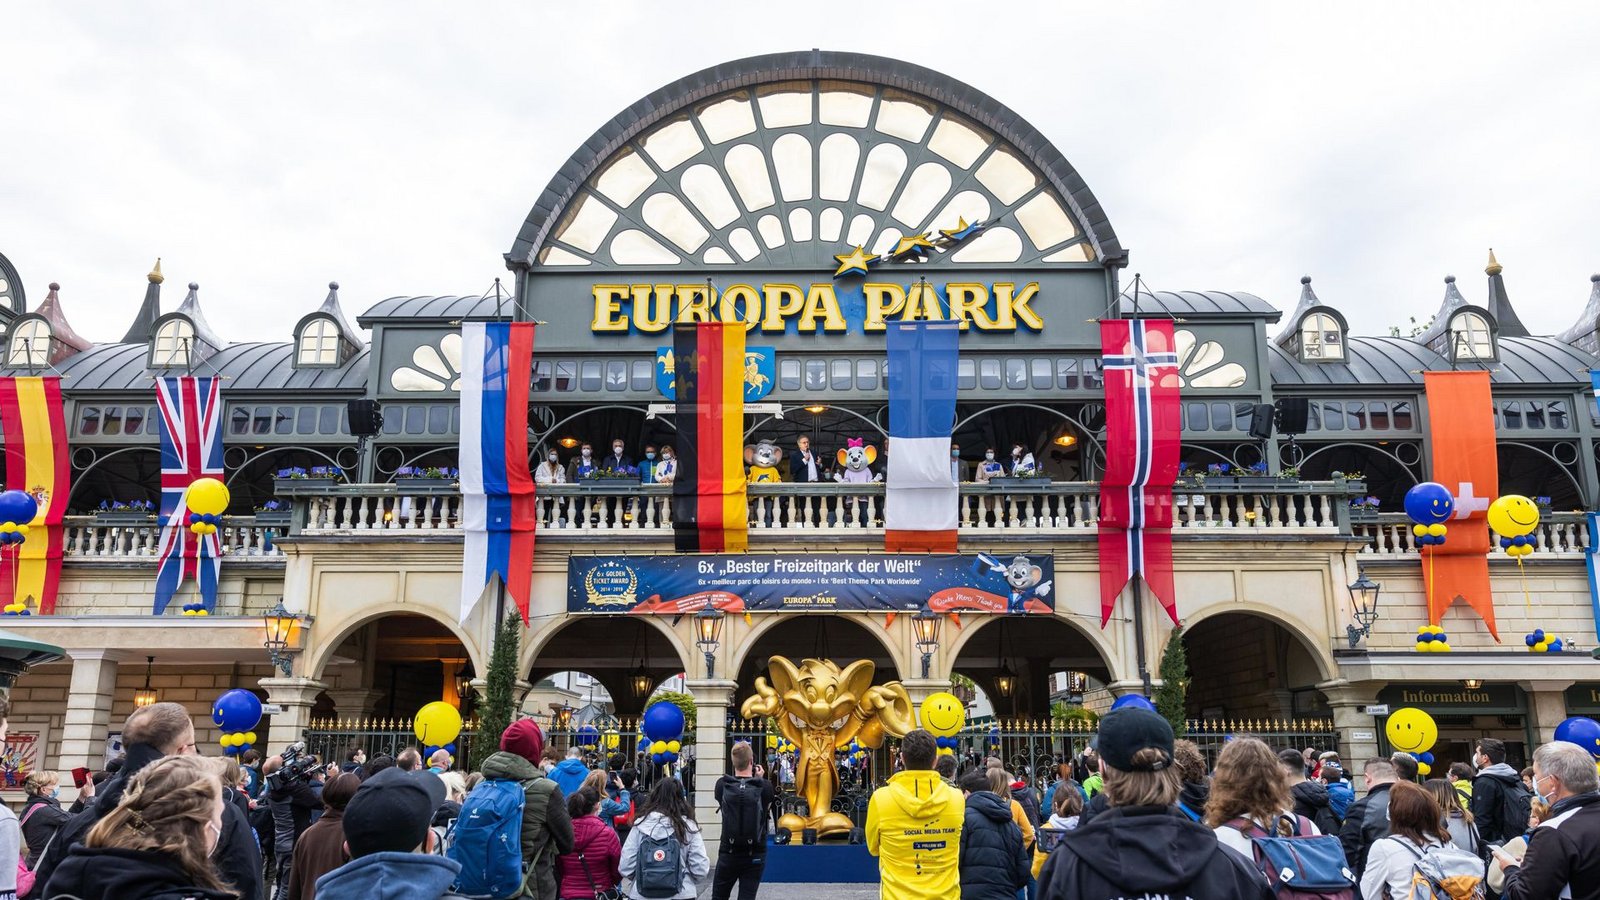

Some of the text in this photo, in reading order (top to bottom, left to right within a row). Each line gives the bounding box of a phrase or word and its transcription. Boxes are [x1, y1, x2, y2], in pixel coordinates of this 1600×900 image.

[592, 282, 1044, 333] EUROPA PARK
[698, 560, 715, 573] 6x
[774, 559, 854, 575] Freizeitpark
[857, 559, 880, 573] der
[783, 596, 837, 604] EUROPA PARK
[1403, 690, 1490, 703] Information
